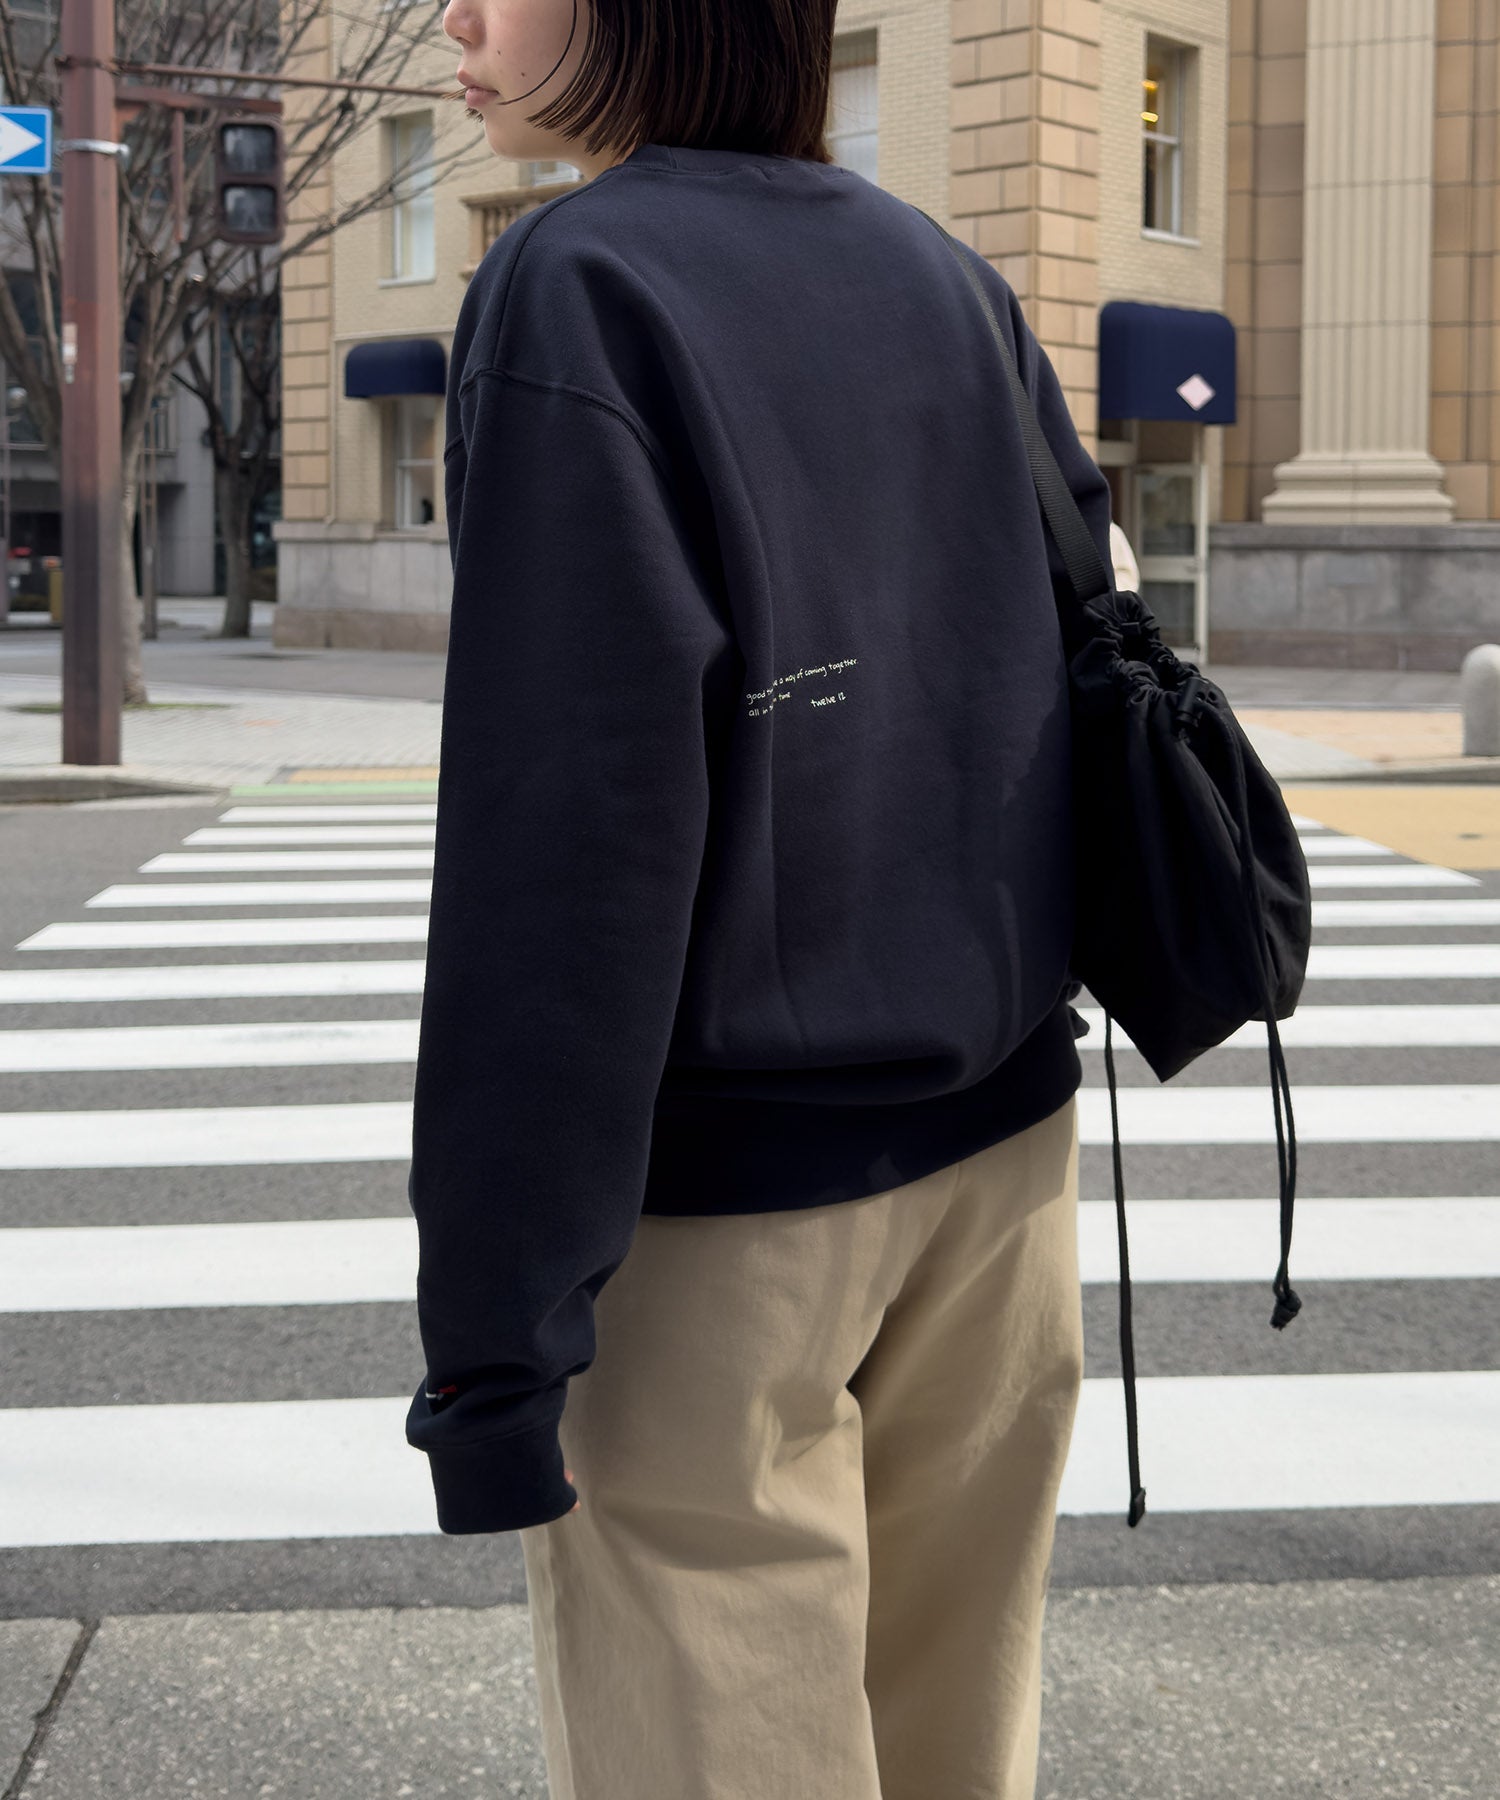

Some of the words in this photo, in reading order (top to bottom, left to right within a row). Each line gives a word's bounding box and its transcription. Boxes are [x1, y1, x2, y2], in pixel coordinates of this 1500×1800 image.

[746, 690, 766, 705] good
[797, 668, 803, 678] of
[805, 666, 828, 677] coming
[829, 659, 858, 674] together
[811, 695, 836, 708] twelve
[838, 692, 846, 701] 12
[748, 709, 760, 717] all
